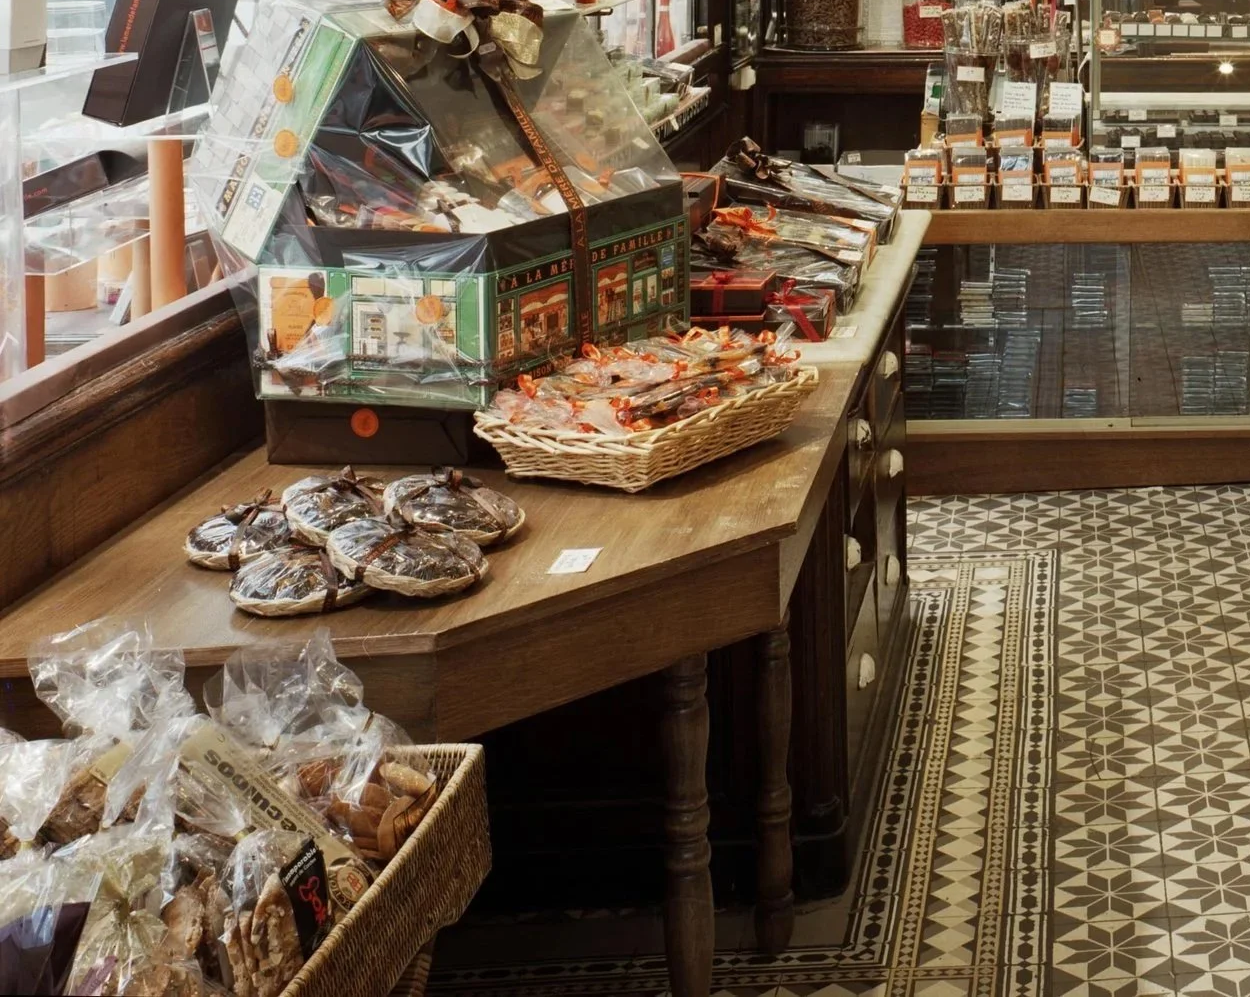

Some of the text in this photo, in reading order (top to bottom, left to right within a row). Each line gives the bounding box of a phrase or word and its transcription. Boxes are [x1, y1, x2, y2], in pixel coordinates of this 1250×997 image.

[526, 269, 543, 284] LA
[592, 246, 607, 262] DE
[613, 230, 664, 256] FAMILLE
